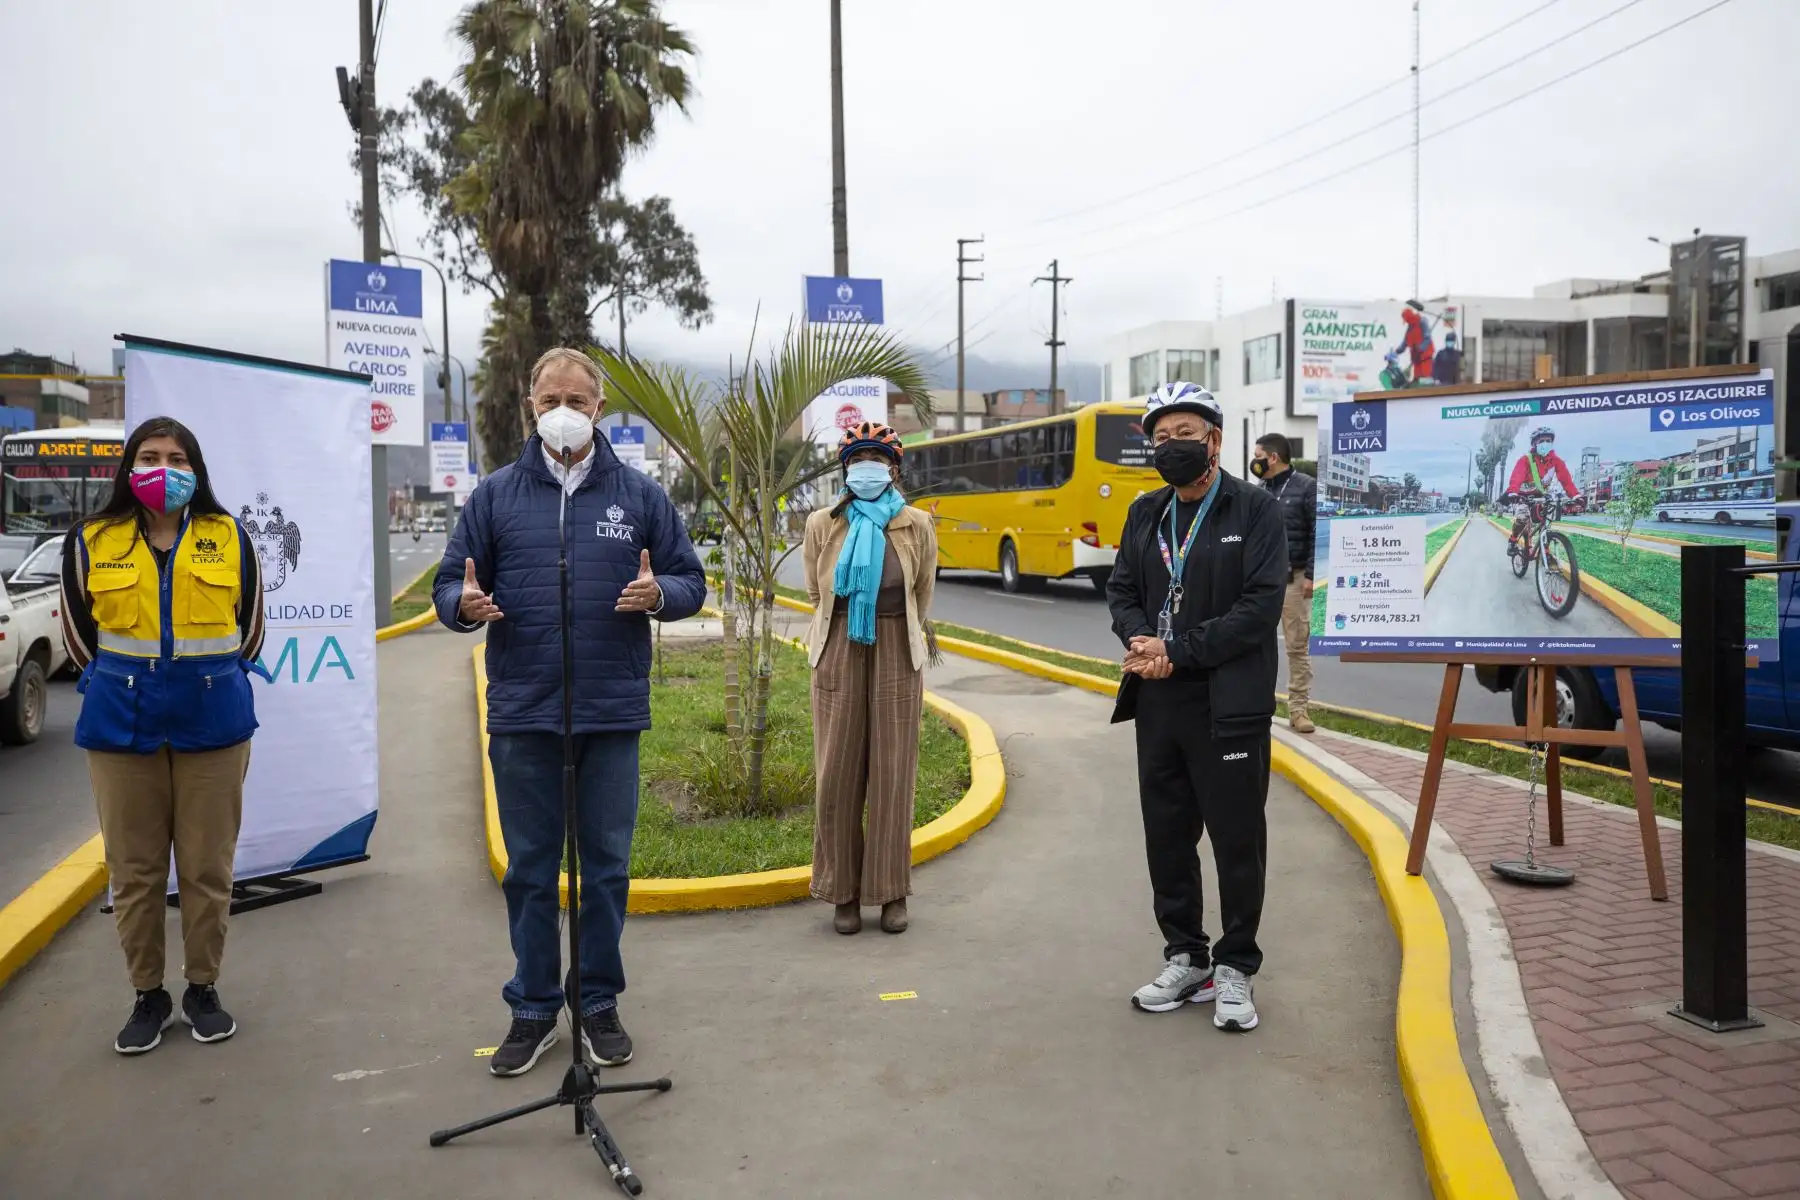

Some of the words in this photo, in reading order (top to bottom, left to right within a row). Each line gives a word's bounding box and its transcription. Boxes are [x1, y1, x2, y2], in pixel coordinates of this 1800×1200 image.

[356, 297, 398, 314] LIMA
[828, 310, 864, 322] LIMA
[1302, 308, 1338, 320] GRAN
[337, 321, 370, 332] NUEVA
[373, 324, 416, 336] CICLOVÍA
[1302, 318, 1387, 338] AMNISTÍA
[344, 342, 411, 358] AVENIDA
[1303, 339, 1374, 351] TRIBUTARIA
[349, 361, 406, 376] CARLOS
[1447, 407, 1481, 417] NUEVA
[1483, 403, 1532, 415] CICLOVÍA
[1547, 397, 1612, 412] AVENIDA
[1615, 391, 1676, 406] CARLOS
[1680, 384, 1766, 402] IZAGUIRRE
[1681, 411, 1707, 423] Los
[1710, 406, 1760, 420] Olivos
[5, 443, 34, 457] CALLAO
[1338, 437, 1382, 451] LIMA
[257, 509, 268, 517] IK
[596, 526, 633, 542] LIMA
[1362, 538, 1378, 548] 1.8
[1381, 537, 1402, 547] km
[1370, 571, 1382, 579] de
[1361, 580, 1372, 588] 32
[1374, 579, 1390, 588] mil
[330, 604, 353, 619] DE
[1223, 752, 1248, 761] adidas
